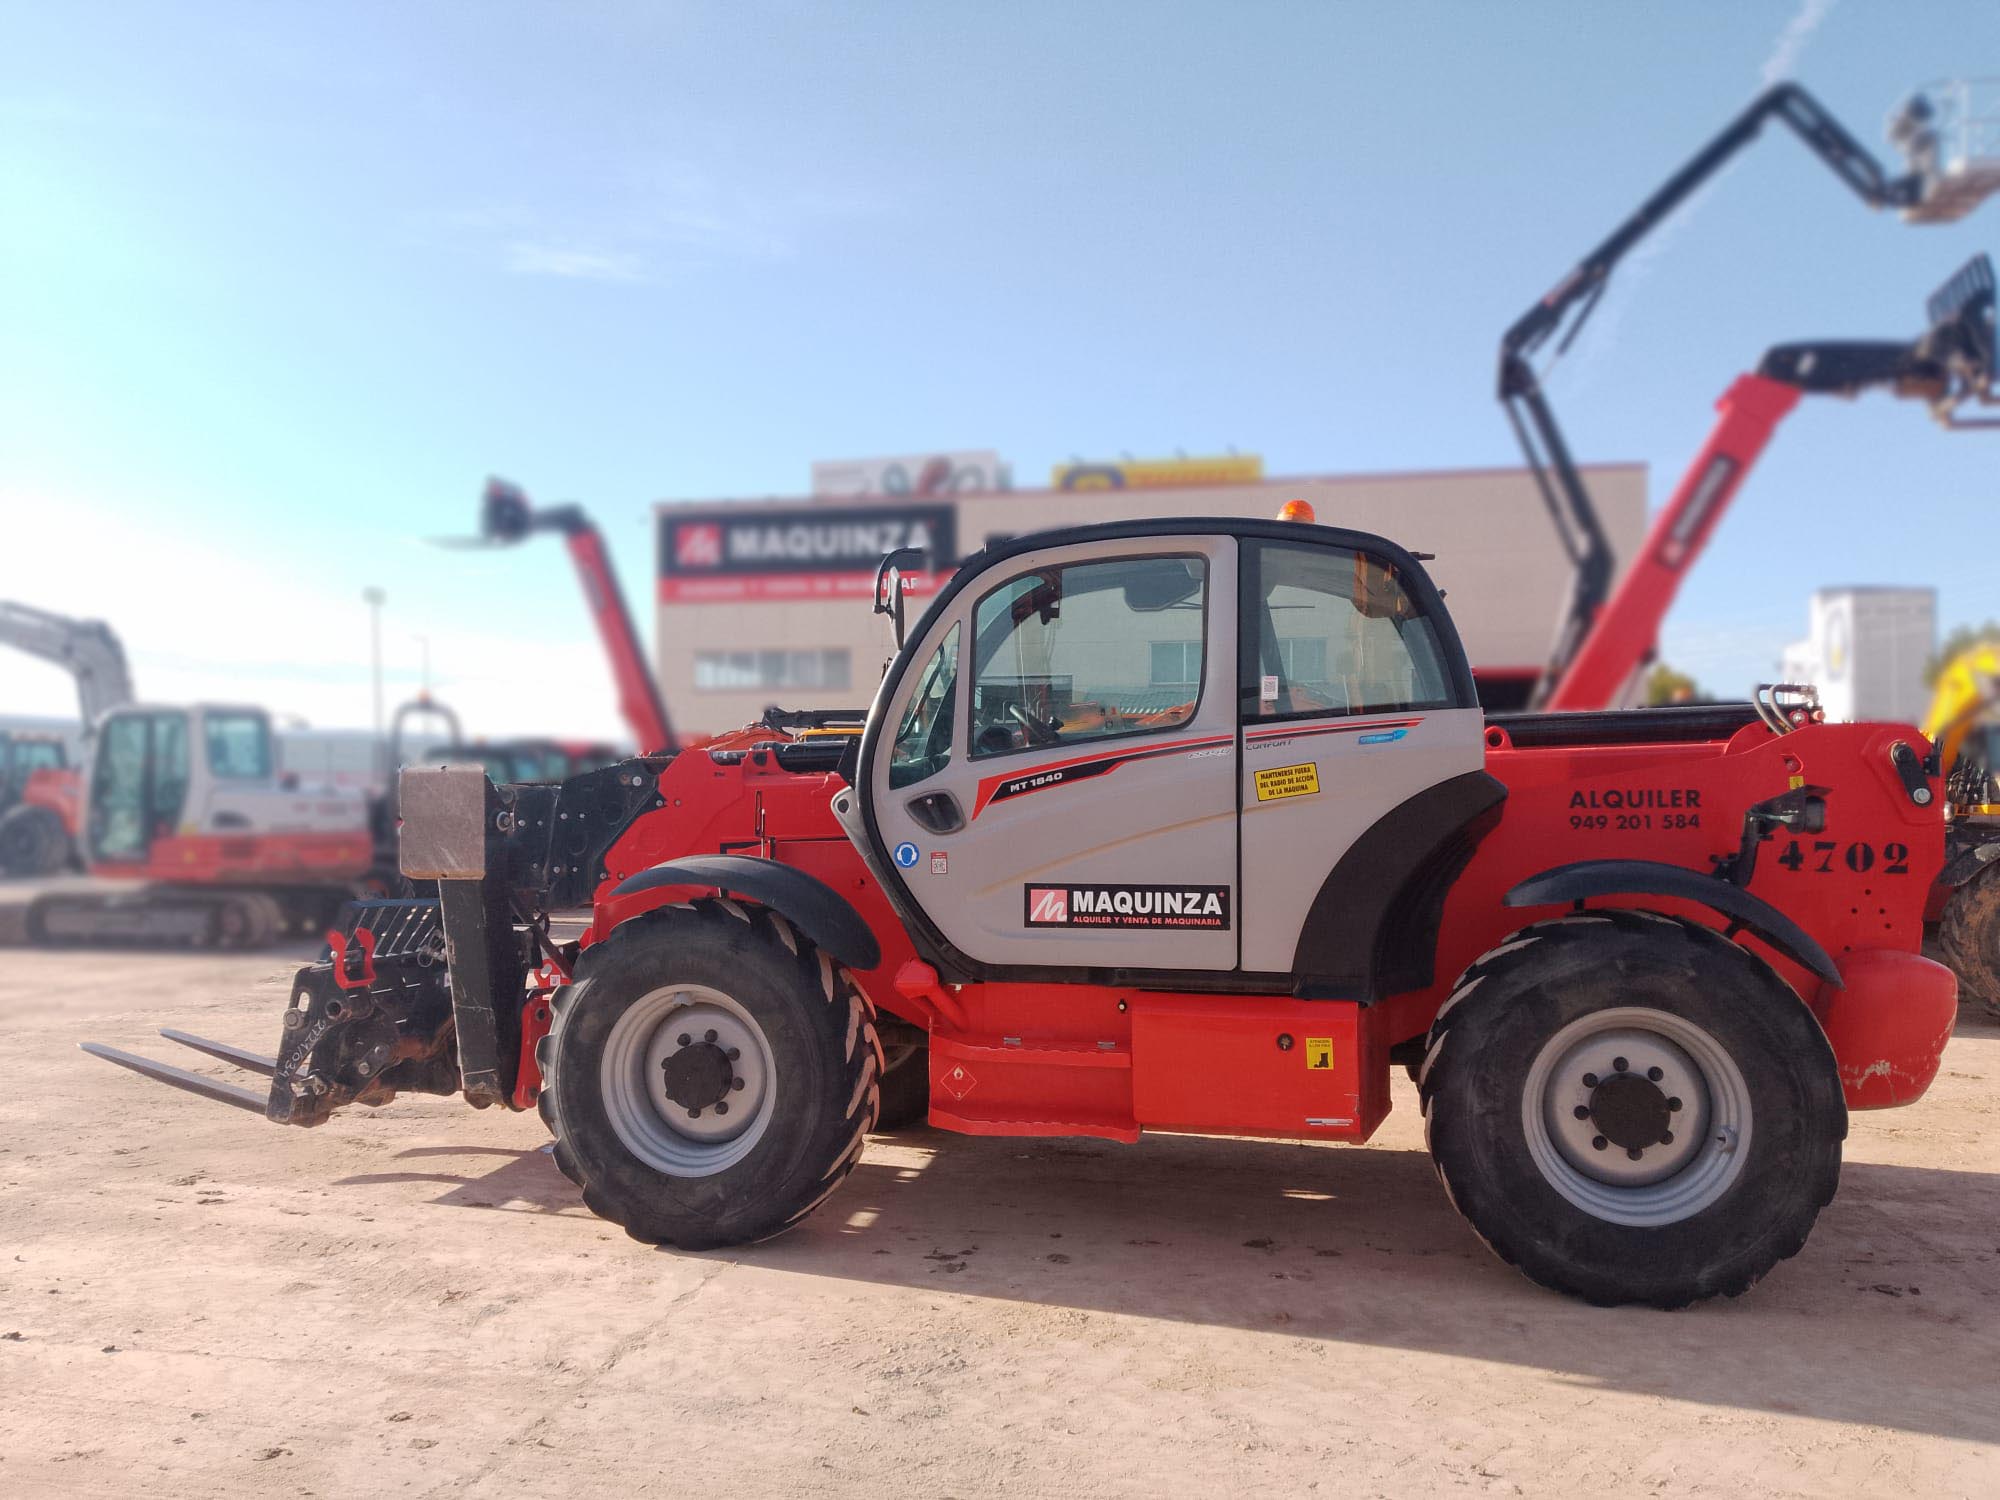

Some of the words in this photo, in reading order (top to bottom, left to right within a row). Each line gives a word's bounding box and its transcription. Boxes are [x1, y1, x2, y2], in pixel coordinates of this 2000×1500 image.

[729, 520, 933, 561] MAQUINZA
[1295, 766, 1311, 775] FUERA
[1010, 781, 1028, 792] MT
[1030, 772, 1063, 787] 1840
[1260, 781, 1269, 789] DEL
[1270, 779, 1287, 787] RADIO
[1287, 777, 1295, 785] DE
[1276, 787, 1283, 795] LA
[1569, 790, 1702, 809] ALQUILER
[1569, 815, 1608, 829] 949
[1616, 814, 1651, 829] 201
[1663, 814, 1699, 829] 584
[1778, 840, 1909, 874] 4702
[1072, 891, 1222, 915] MAQUINZA
[1073, 916, 1112, 924] ALQUILER
[1122, 917, 1149, 925] VENTA
[1151, 917, 1162, 925] DE
[1165, 918, 1222, 926] MAQUINARIA
